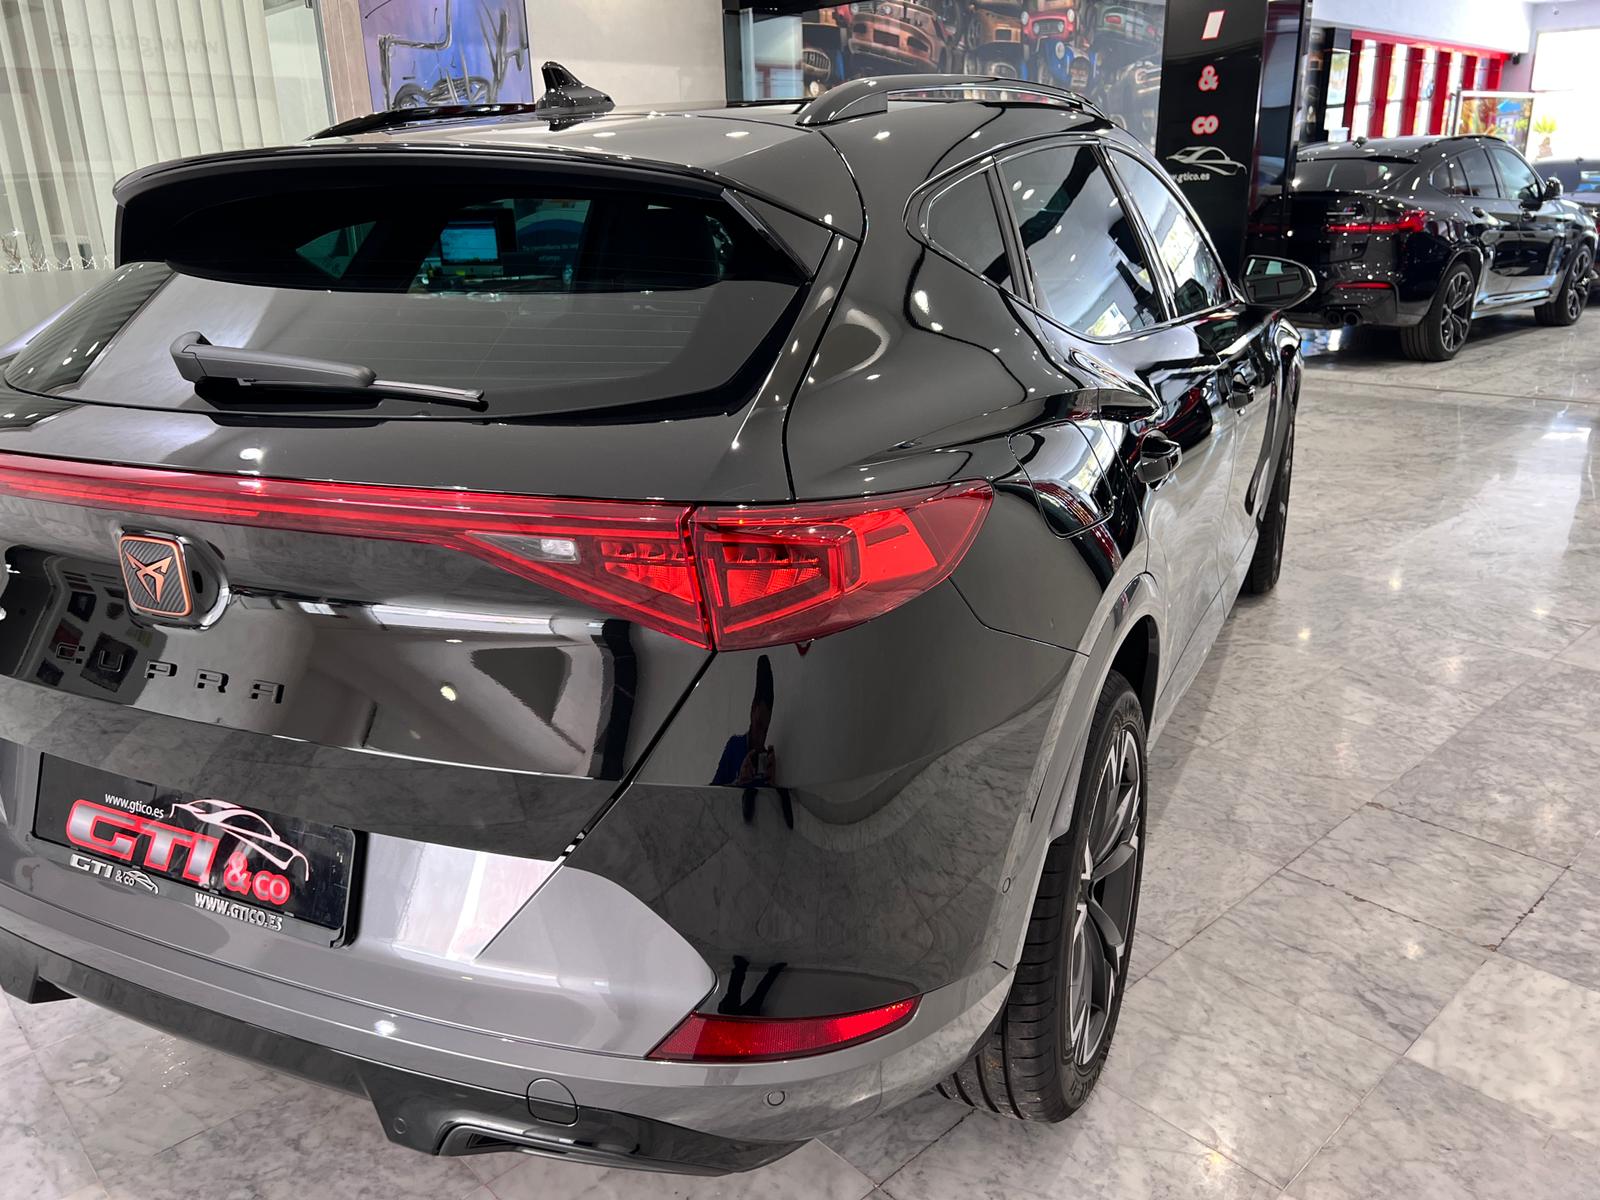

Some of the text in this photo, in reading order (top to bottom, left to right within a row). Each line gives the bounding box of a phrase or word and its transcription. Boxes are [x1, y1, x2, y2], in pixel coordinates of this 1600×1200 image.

[1198, 65, 1219, 91] &
[56, 642, 286, 704] CUPRA
[104, 793, 165, 819] www.gtico.es
[66, 799, 220, 884] GTI
[70, 853, 113, 878] GTI
[195, 892, 283, 931] WWW.GTICO.ES
